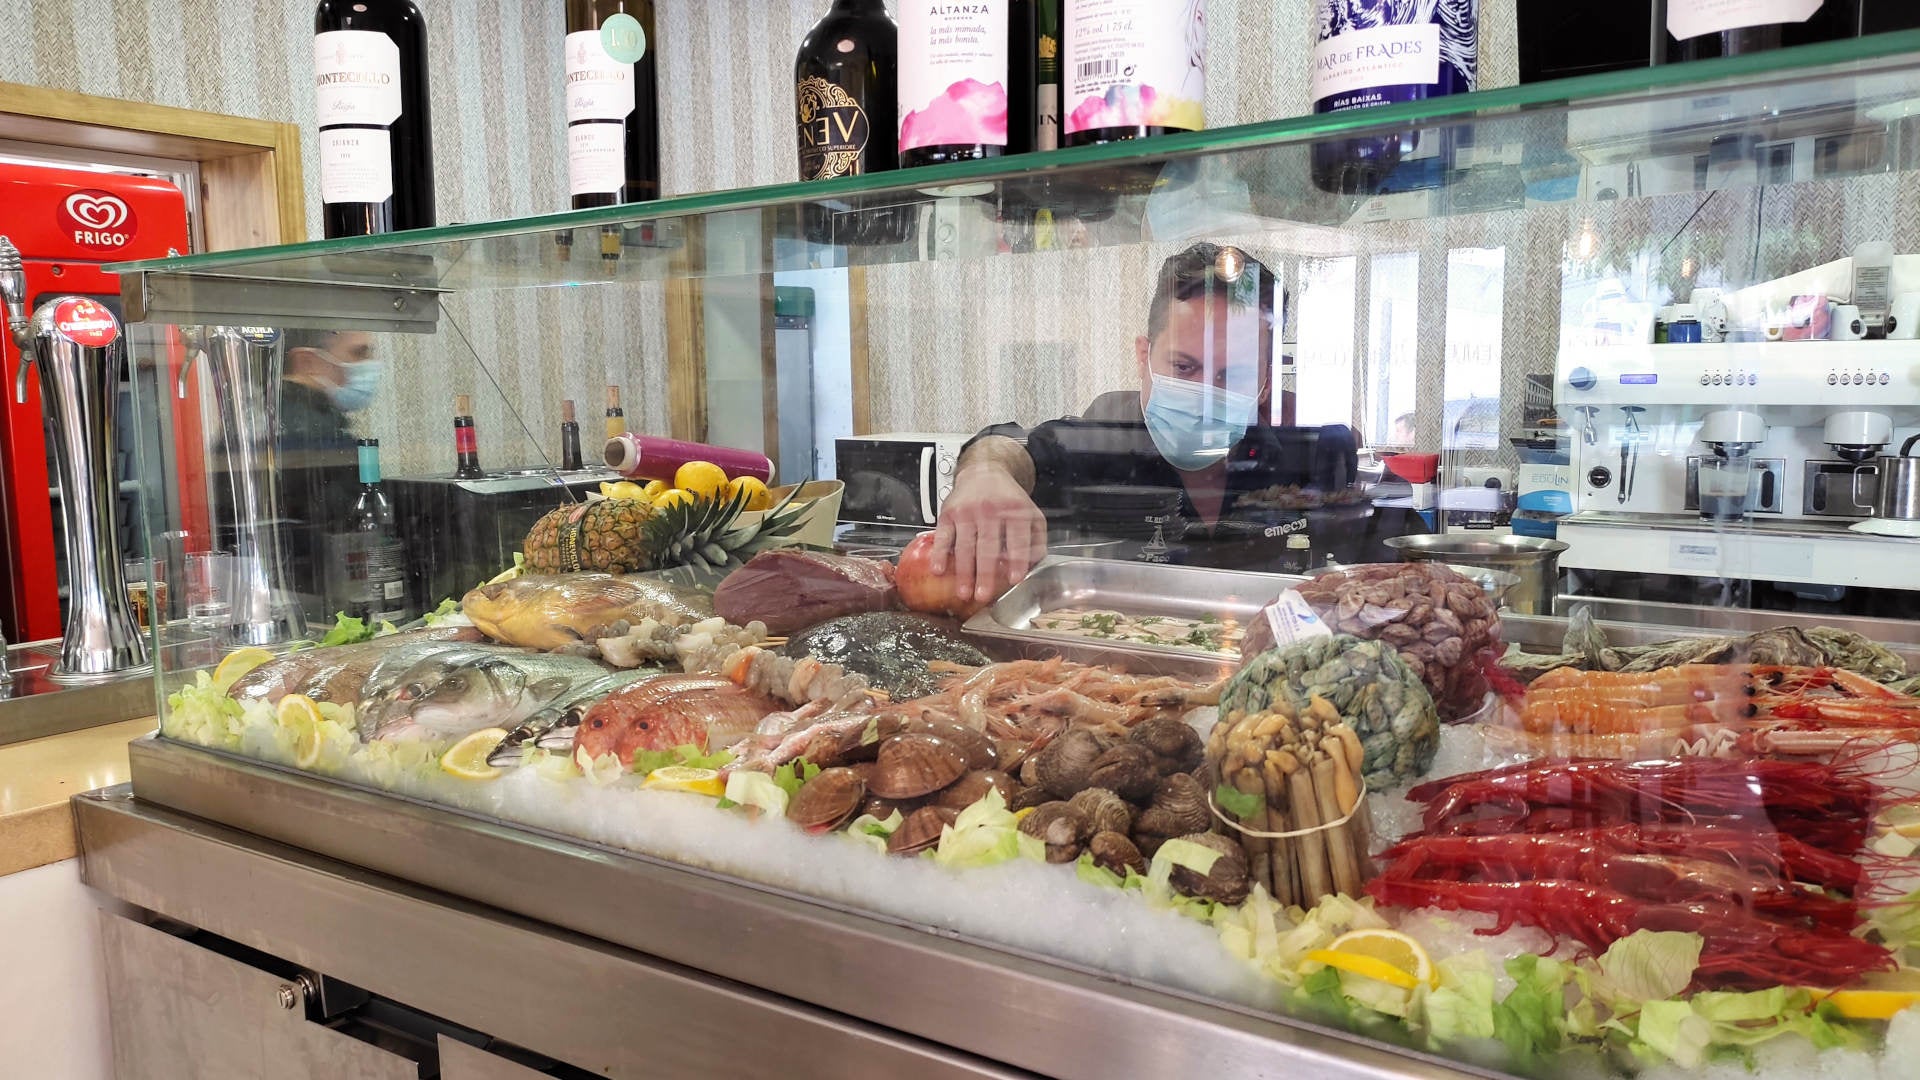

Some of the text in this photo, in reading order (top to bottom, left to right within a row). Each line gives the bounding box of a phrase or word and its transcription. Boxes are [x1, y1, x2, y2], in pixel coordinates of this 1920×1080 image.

[929, 4, 989, 16] ALTANZA
[930, 26, 936, 35] la
[930, 37, 936, 45] la
[1317, 40, 1422, 70] MAR DE FRADES
[1333, 93, 1382, 108] RÍAS BAIXAS
[827, 143, 857, 152] SUPERIORE
[74, 230, 125, 246] FRIGO
